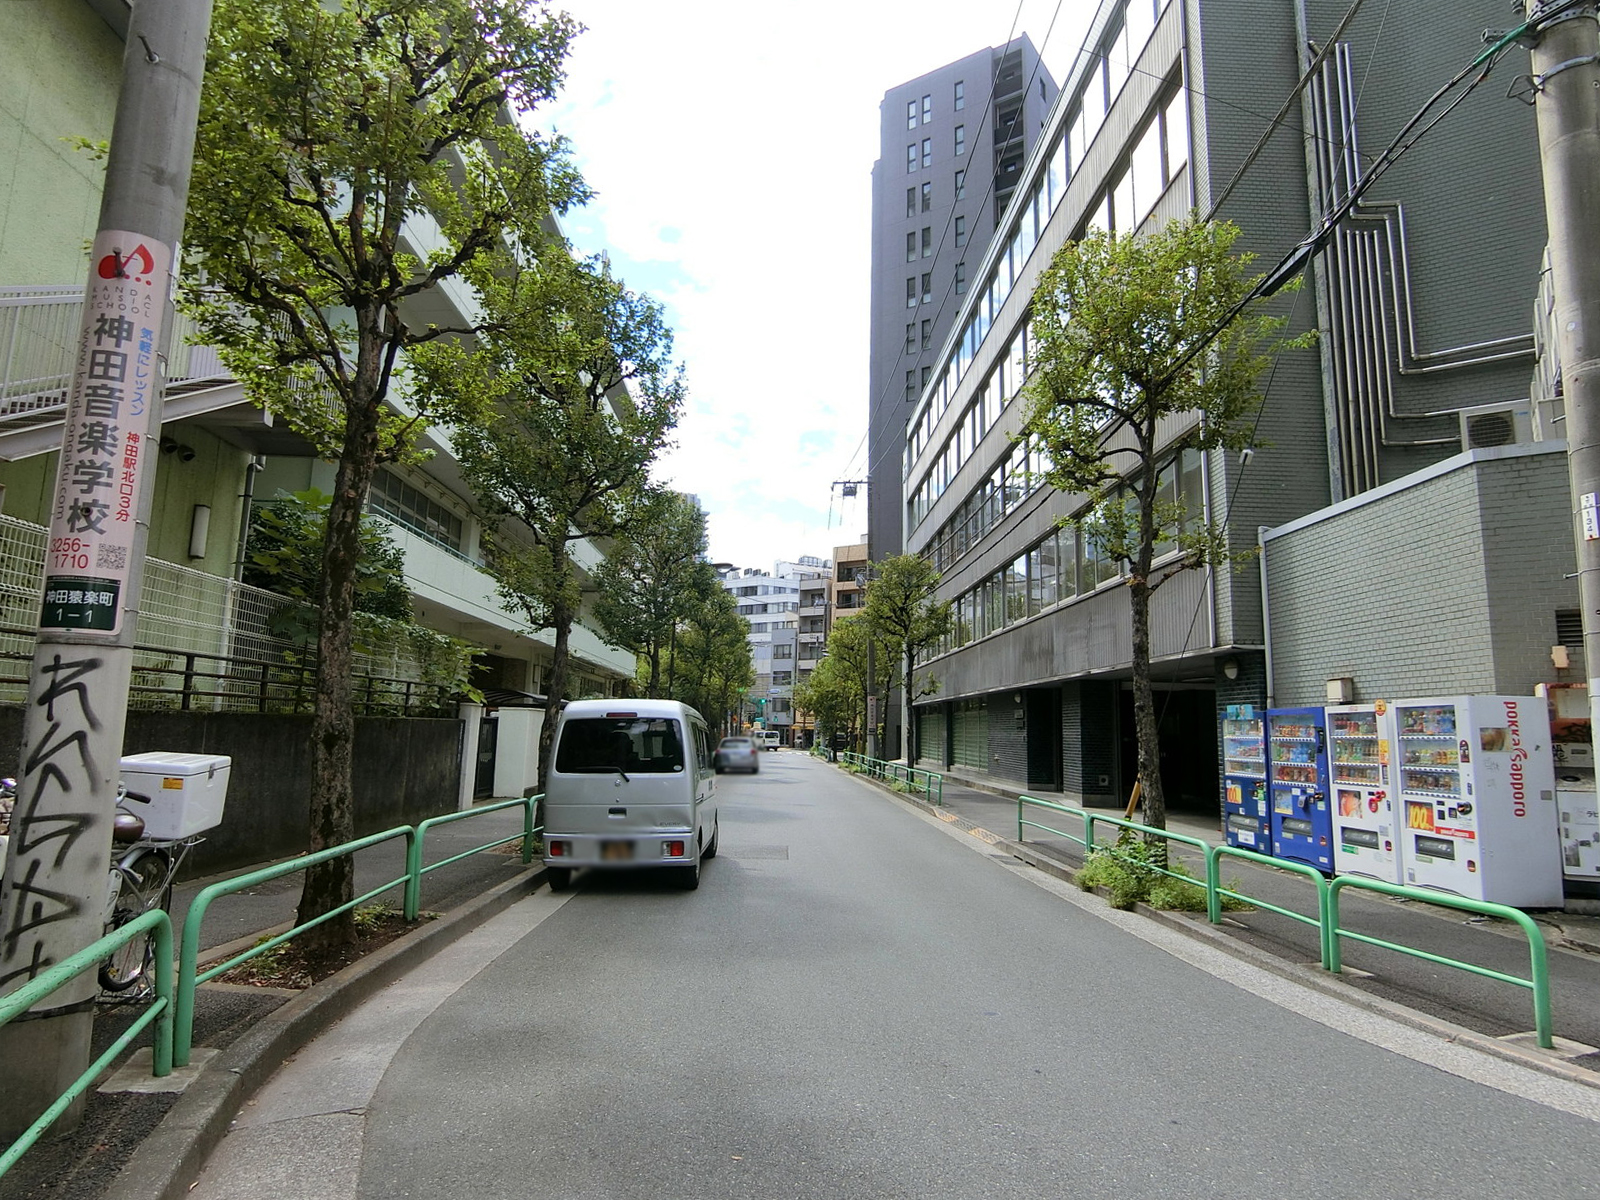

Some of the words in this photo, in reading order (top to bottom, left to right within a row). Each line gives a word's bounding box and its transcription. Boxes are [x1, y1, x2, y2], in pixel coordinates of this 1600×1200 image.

[91, 294, 152, 310] MUSIC
[92, 285, 152, 302] KANDA
[90, 302, 150, 318] SCHOOL
[129, 327, 154, 417] 気軽にレッスン
[55, 326, 92, 521] www.kanda-ongaku.com
[66, 312, 135, 536] 神田音楽学校
[115, 431, 141, 522] 神田駅北口3分
[53, 553, 89, 570] 1710
[46, 589, 115, 607] 神田猿楽町
